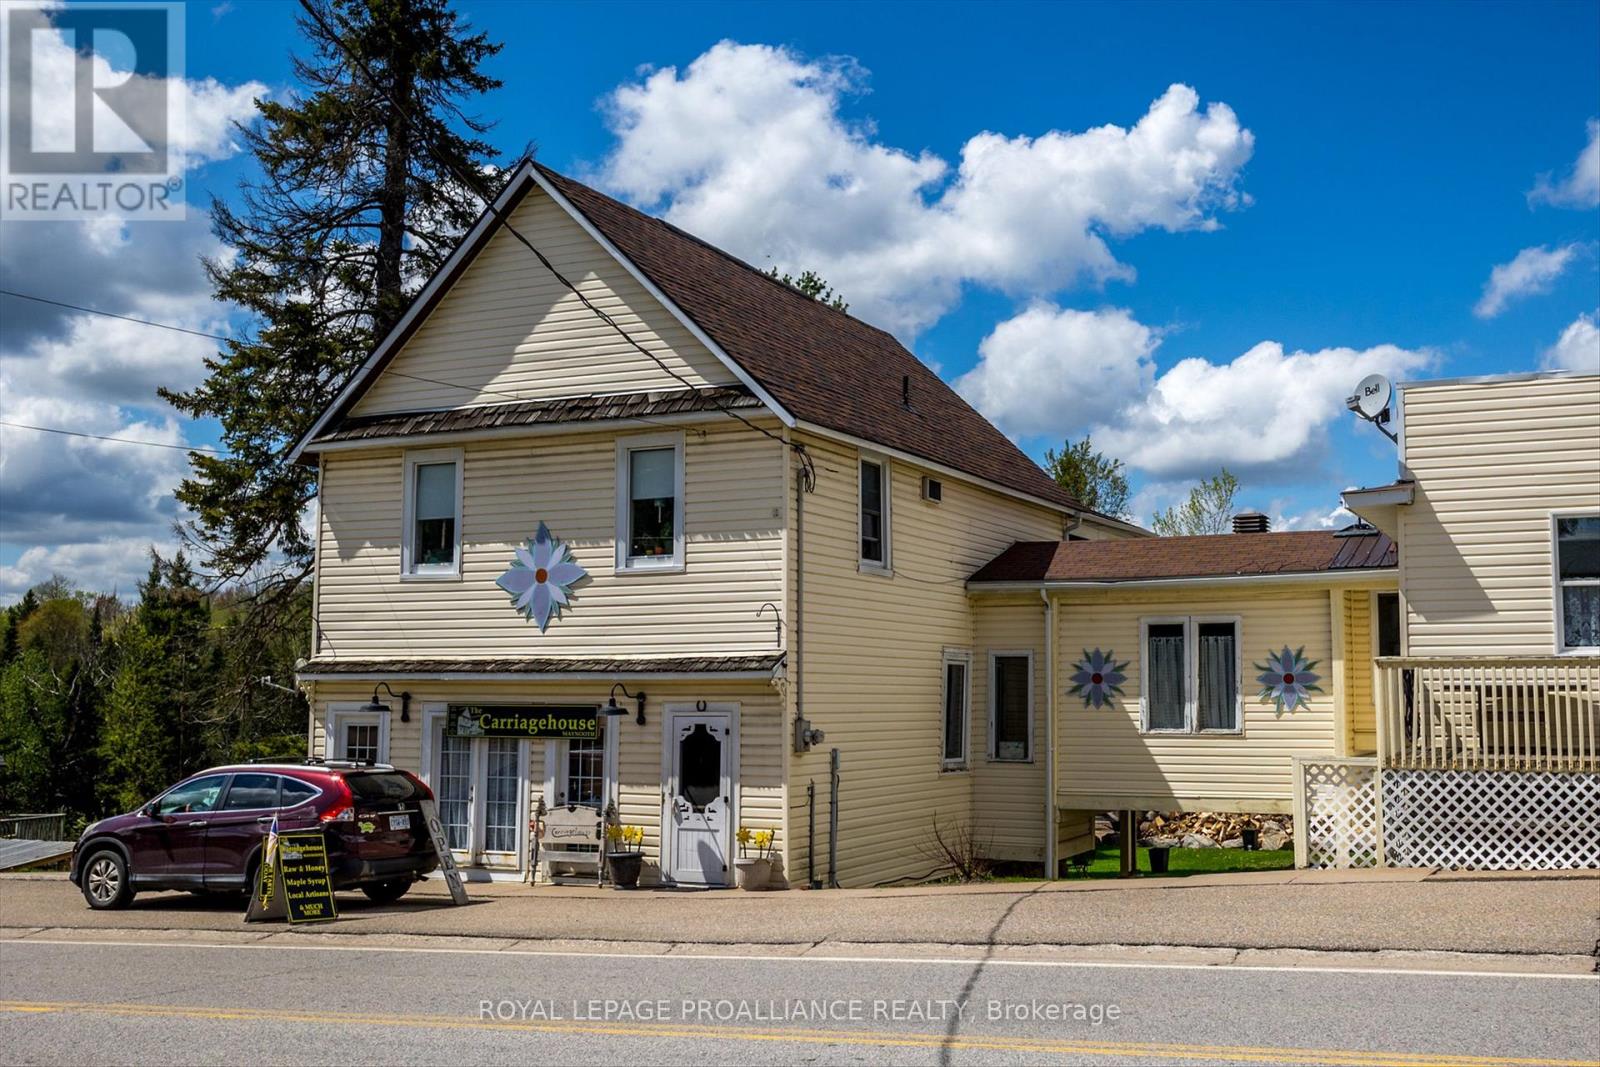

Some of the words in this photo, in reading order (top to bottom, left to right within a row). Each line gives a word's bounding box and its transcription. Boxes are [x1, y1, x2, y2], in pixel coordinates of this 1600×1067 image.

[1364, 383, 1380, 397] Bell
[470, 706, 483, 715] The
[479, 713, 596, 735] Carriagehouse
[430, 818, 461, 892] OPEN
[305, 864, 325, 873] Honey
[287, 878, 307, 887] Maple
[308, 878, 326, 887] Syrup
[288, 891, 304, 899] Local
